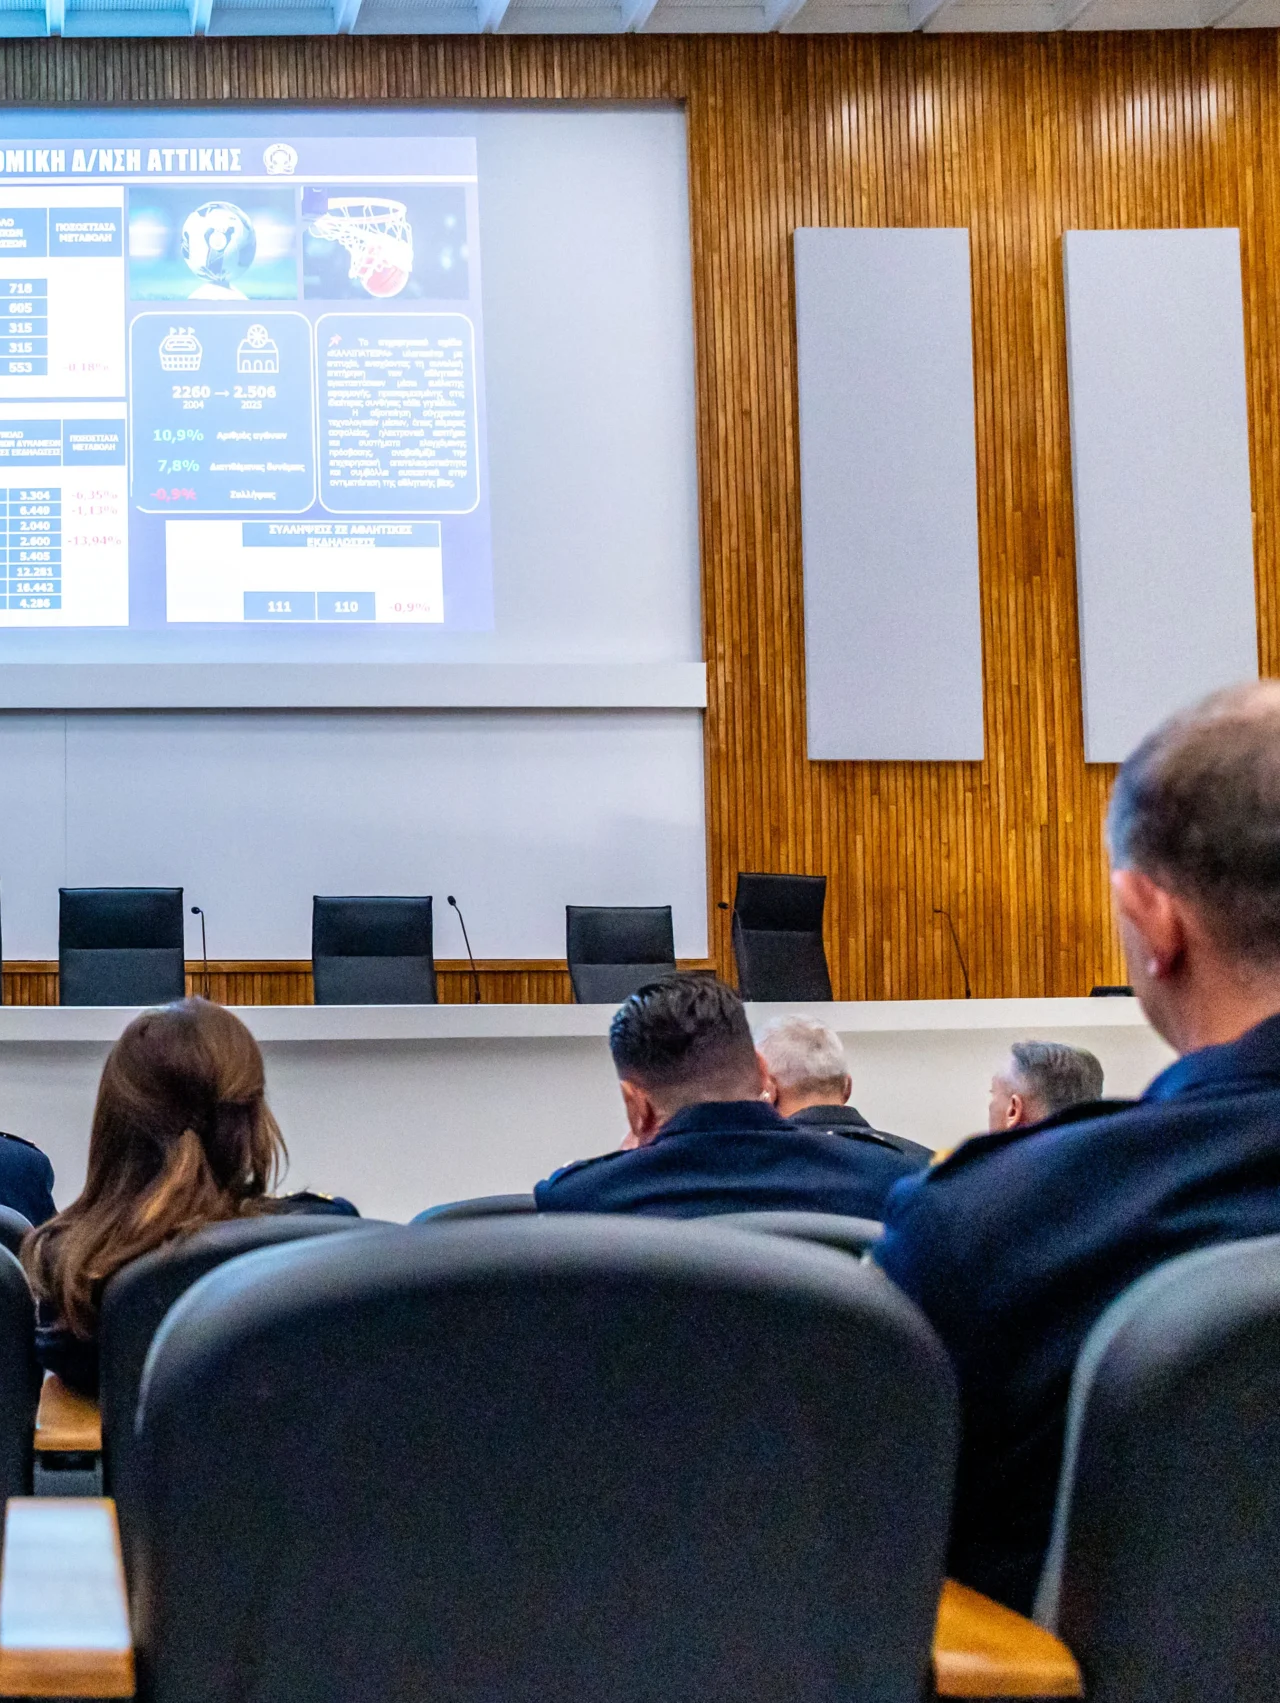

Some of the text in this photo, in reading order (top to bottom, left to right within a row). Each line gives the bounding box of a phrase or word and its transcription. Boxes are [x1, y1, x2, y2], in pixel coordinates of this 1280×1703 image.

[72, 149, 141, 172] Δ/ΝΣΗ
[147, 148, 241, 171] ΑΤΤΙΚΗΣ
[9, 283, 32, 294] 718
[9, 303, 32, 313] 605
[9, 322, 32, 333] 315
[9, 342, 32, 353] 315
[9, 362, 32, 372] 553
[172, 385, 276, 398] 2260 2.506
[241, 400, 262, 409] 2025
[153, 429, 204, 443] 10,9%
[158, 460, 200, 474] 7,8%
[20, 491, 50, 500] 3.304
[151, 488, 196, 502] -0,9%
[20, 521, 50, 531] 2.040
[269, 524, 332, 534] ΣΥΛΛΗΨΕΙΣ
[20, 537, 50, 547] 2.600
[20, 552, 50, 561] 5.405
[17, 567, 53, 577] 12.281
[17, 583, 53, 592] 16.442
[268, 601, 291, 612] 111
[335, 601, 358, 612] 110
